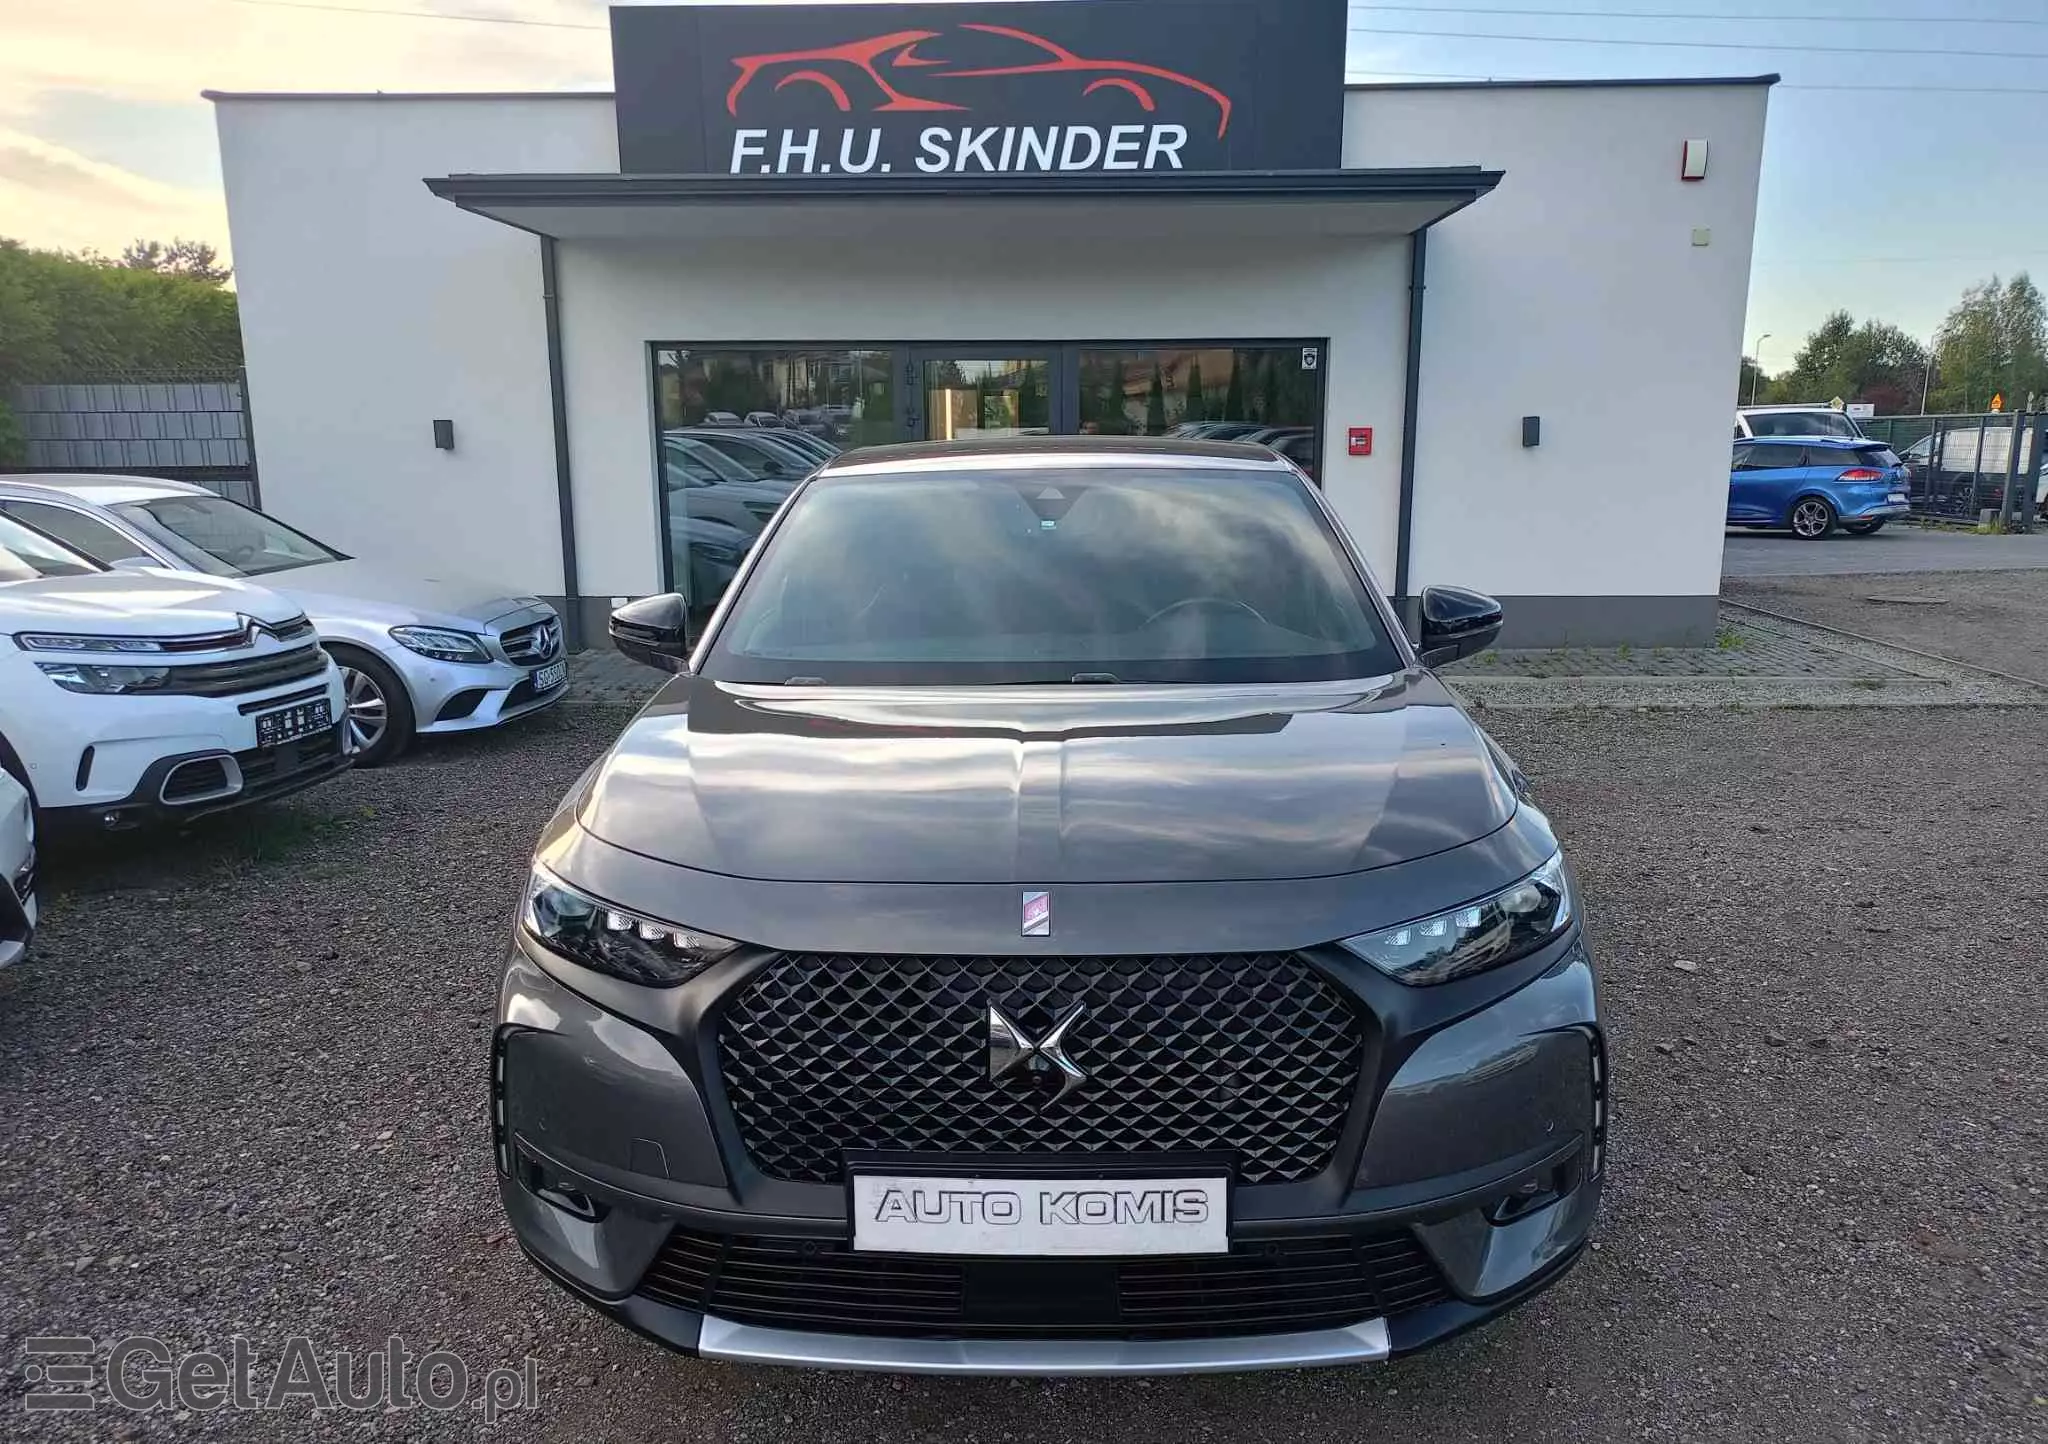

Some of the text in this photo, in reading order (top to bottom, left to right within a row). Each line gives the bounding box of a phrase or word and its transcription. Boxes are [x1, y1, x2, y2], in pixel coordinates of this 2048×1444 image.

[730, 123, 1188, 173] F.H.U. SKINDER
[874, 1188, 1209, 1226] AUTO KOMIS
